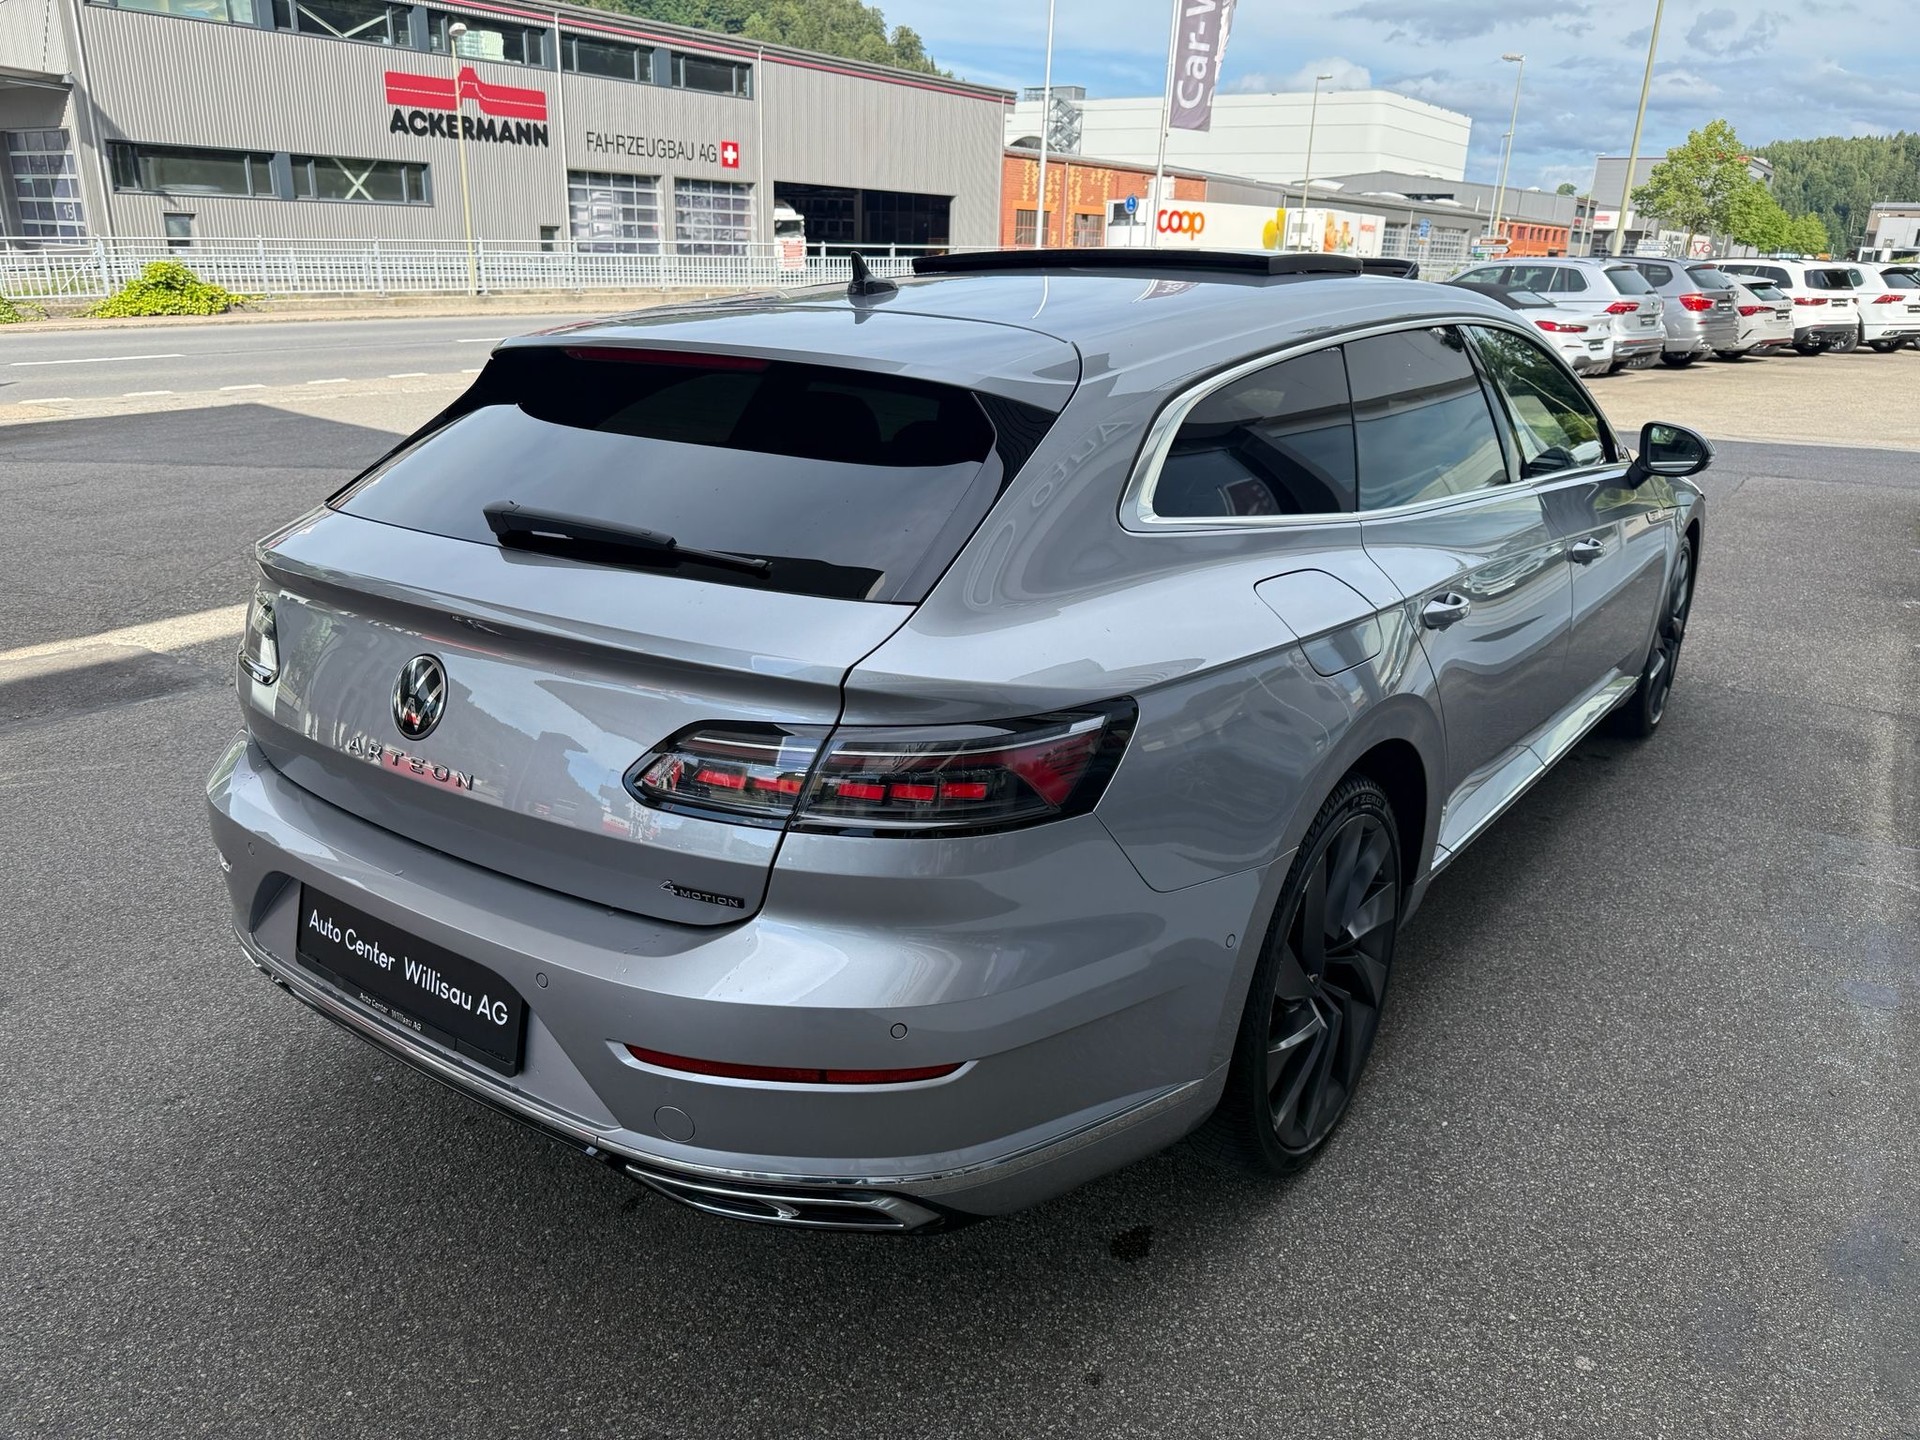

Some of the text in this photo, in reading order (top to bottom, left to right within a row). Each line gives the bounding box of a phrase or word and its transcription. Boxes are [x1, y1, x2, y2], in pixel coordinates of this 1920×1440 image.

[390, 108, 549, 147] ACKERMANN
[586, 131, 718, 163] FAHRZEUGBAU AG
[1157, 209, 1205, 240] coop
[349, 736, 474, 791] ARTEON
[659, 880, 739, 908] 4MOTION
[309, 908, 509, 1026] Auto Center Willisau AG
[371, 999, 389, 1014] Center
[412, 1021, 422, 1032] AG
